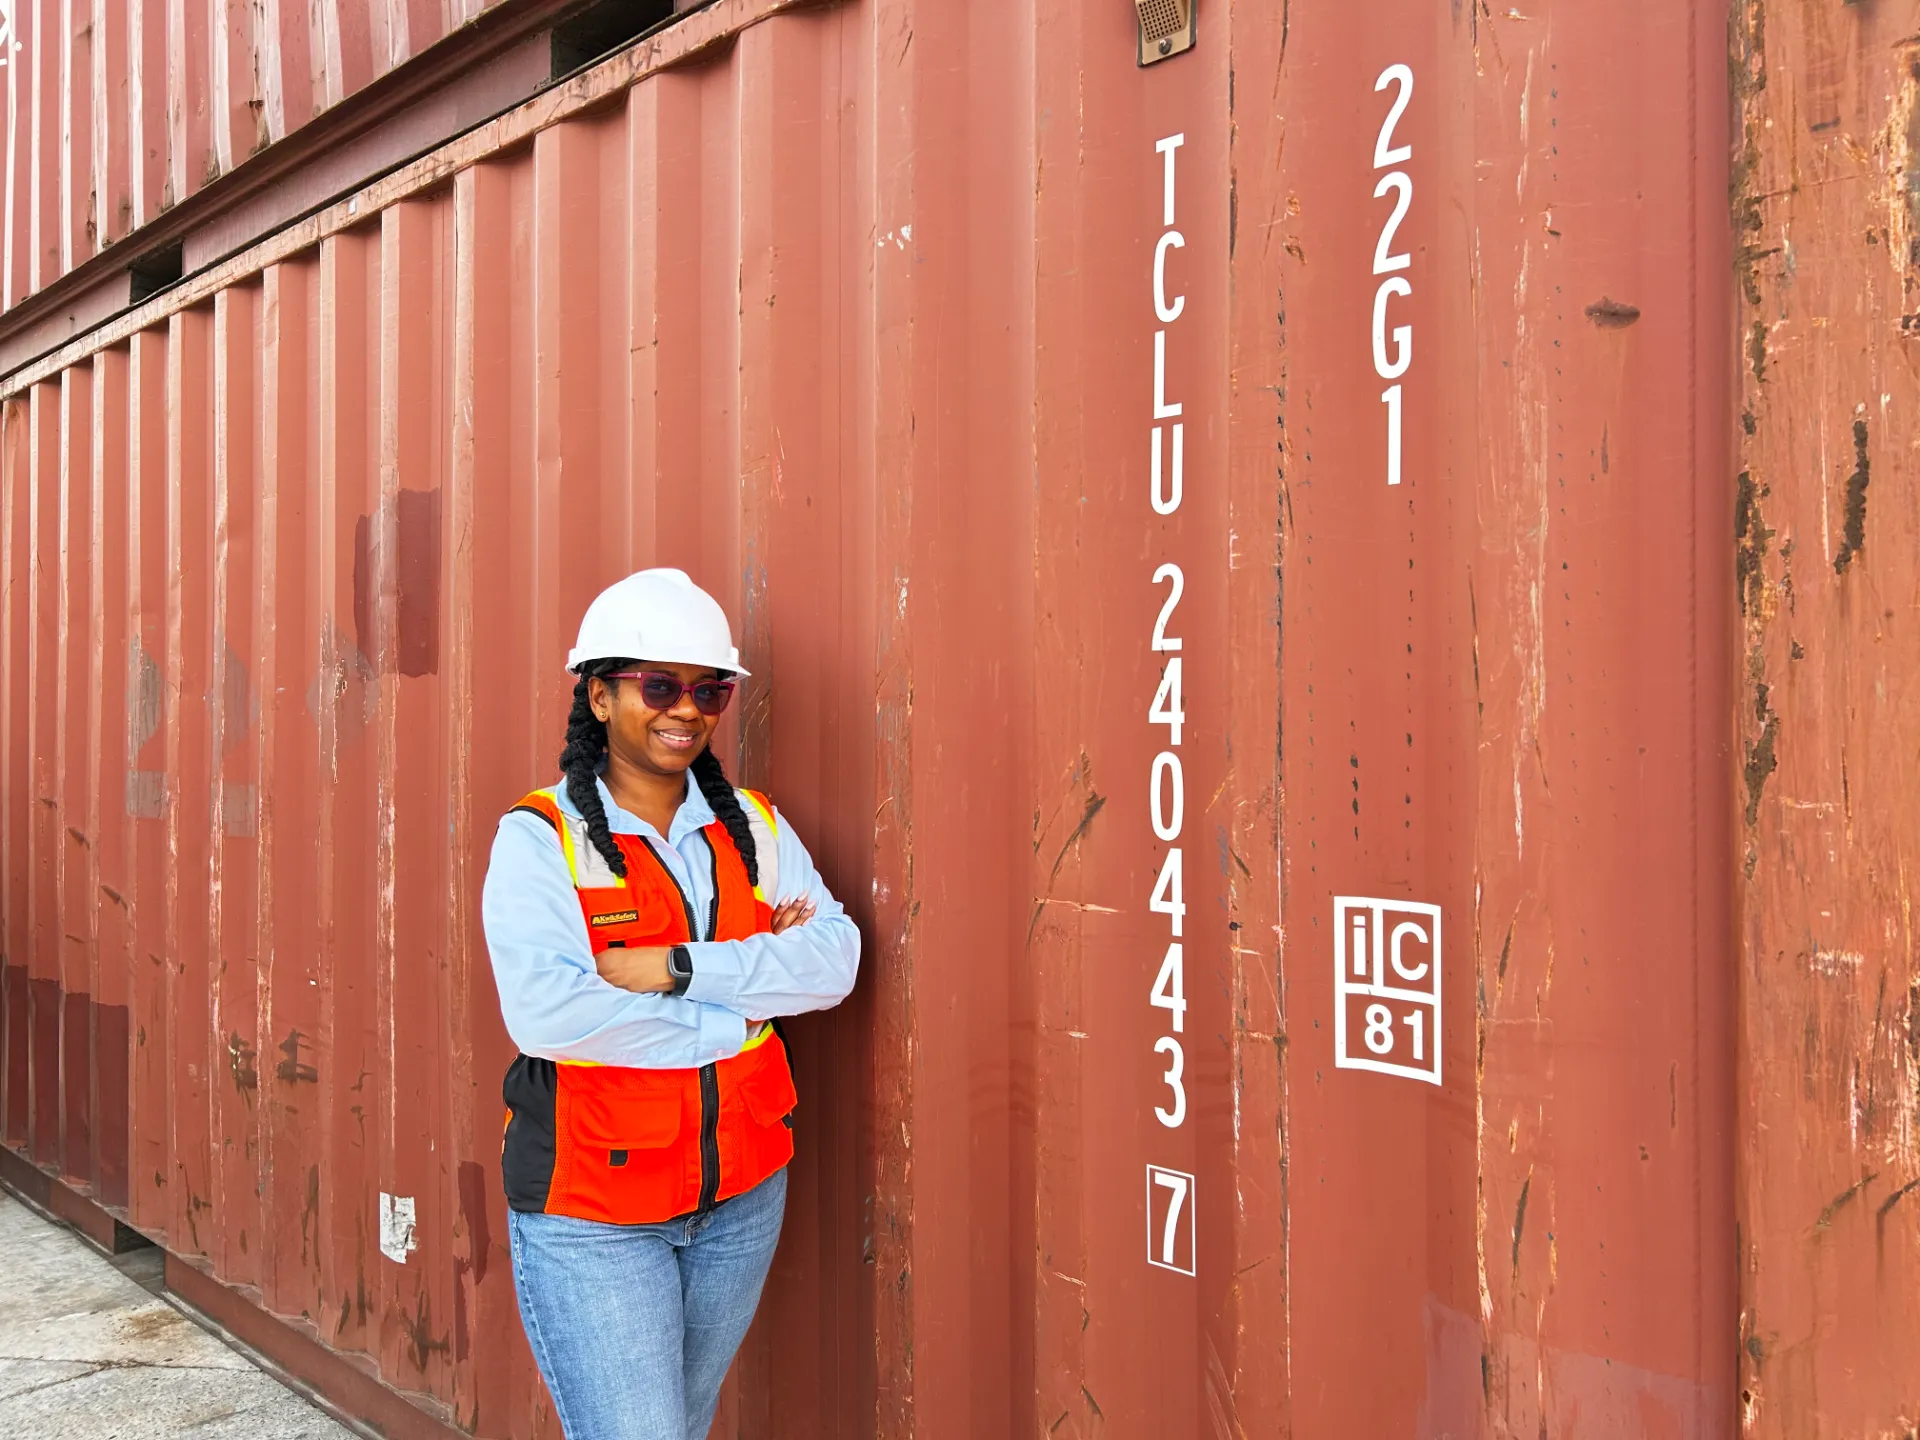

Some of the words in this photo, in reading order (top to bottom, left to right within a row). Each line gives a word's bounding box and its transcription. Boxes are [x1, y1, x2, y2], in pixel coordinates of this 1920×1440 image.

[1150, 132, 1186, 516] TCLU
[1371, 63, 1414, 486] 22G1
[1148, 562, 1187, 1129] 240443
[1364, 1003, 1424, 1061] 81
[1154, 1171, 1187, 1265] 7
